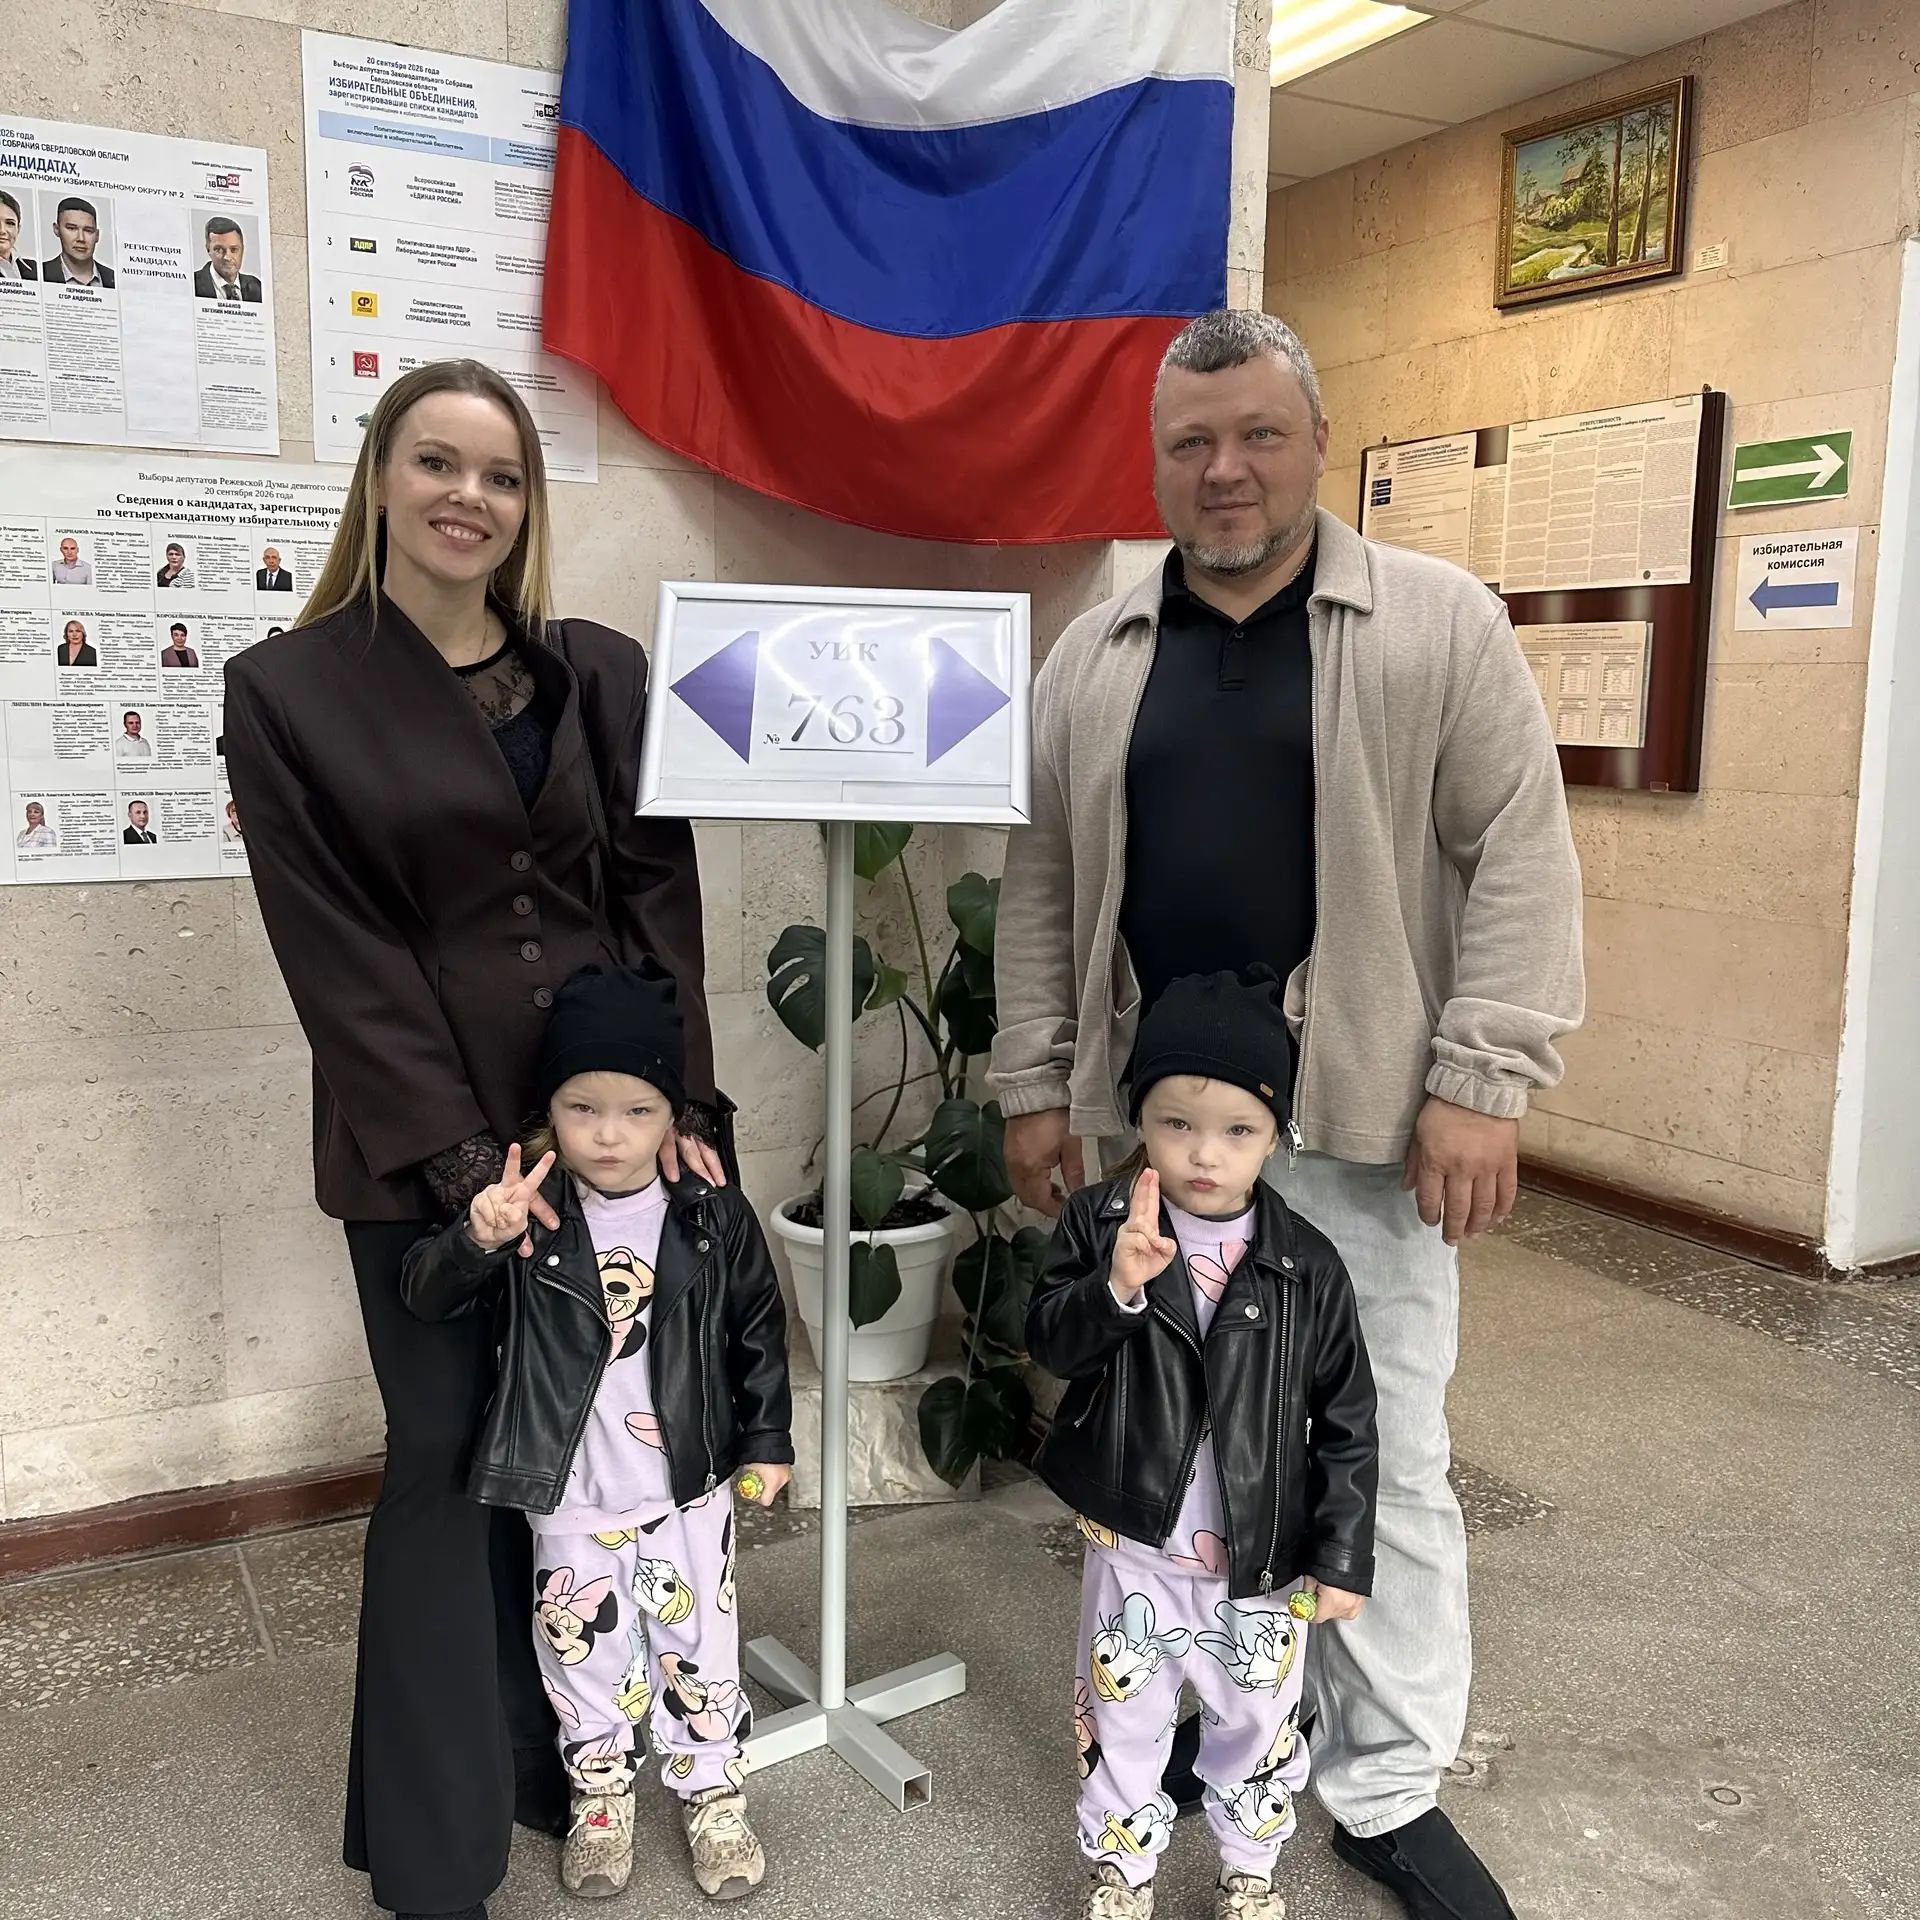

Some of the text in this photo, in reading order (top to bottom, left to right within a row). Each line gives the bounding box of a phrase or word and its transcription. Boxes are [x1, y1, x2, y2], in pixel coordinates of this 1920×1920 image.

[366, 56, 440, 76] 20 сентября 2026 года
[333, 60, 473, 90] Выборы депутатов Законодательного Собрания
[370, 75, 438, 92] Свердловской области
[329, 76, 478, 111] ИЗБИРАТЕЛЬНЫЕ ОБЪЕДИНЕНИЯ,
[328, 90, 479, 121] зарегистрировавшие списки кандидатов
[535, 109, 544, 117] 18
[545, 107, 554, 116] 19
[0, 128, 35, 141] 026 года
[373, 125, 415, 137] Политические
[389, 135, 433, 146] избирательный
[434, 141, 464, 151] бюллетень
[2, 139, 130, 162] СОБРАНИЯ СВЕРДЛОВСКОЙ ОБЛАСТИ
[0, 153, 81, 178] АНДИДАТАХ,
[325, 170, 329, 179] 1
[0, 169, 62, 185] ОМАНДАТНОМУ
[63, 178, 139, 194] ИЗБИРАТЕЛЬНОМУ
[137, 186, 167, 197] ОКРУГУ
[179, 191, 185, 199] 2
[207, 175, 239, 188] 18 19 20
[414, 176, 456, 188] Всероссийская
[350, 191, 374, 199] РОССИЯ
[406, 184, 463, 197] политическая партия
[410, 193, 462, 205] «ЕДИНАЯ РОССИЯ»
[327, 237, 333, 245] 3
[353, 240, 373, 249] ЛДПР
[397, 238, 471, 254] Политическая партия ЛДПР
[123, 242, 182, 255] РЕГИСТРАЦИЯ
[129, 255, 178, 267] КАНДИДАТА
[417, 257, 457, 268] партия России
[121, 267, 187, 281] АННУЛИРОВАНА
[65, 287, 94, 296] ПЕРМИНОВ
[72, 294, 102, 303] АНДРЕЕВИЧ
[329, 297, 334, 305] 4
[412, 298, 463, 310] Социалистическая
[223, 308, 258, 318] МИХАЙЛОВИЧ
[409, 307, 466, 319] политическая партия
[405, 314, 471, 328] СПРАВЕДЛИВАЯ РОССИЯ
[330, 357, 335, 366] 5
[399, 356, 416, 365] КПРФ
[332, 415, 337, 424] 6
[138, 472, 174, 483] Выборы
[175, 476, 218, 487] депутатов
[219, 477, 264, 488] Режевской
[265, 479, 289, 490] Думы
[290, 482, 326, 493] девятого
[204, 486, 294, 501] 20 сентября 2026 года
[116, 493, 345, 517] Сведения о кандидатах, зарегистриров
[96, 508, 331, 530] по четырехмандатному избирательному
[1752, 540, 1843, 556] избирательная
[1767, 557, 1825, 571] комиссия
[808, 640, 879, 661] УИК
[763, 693, 905, 745] № 763
